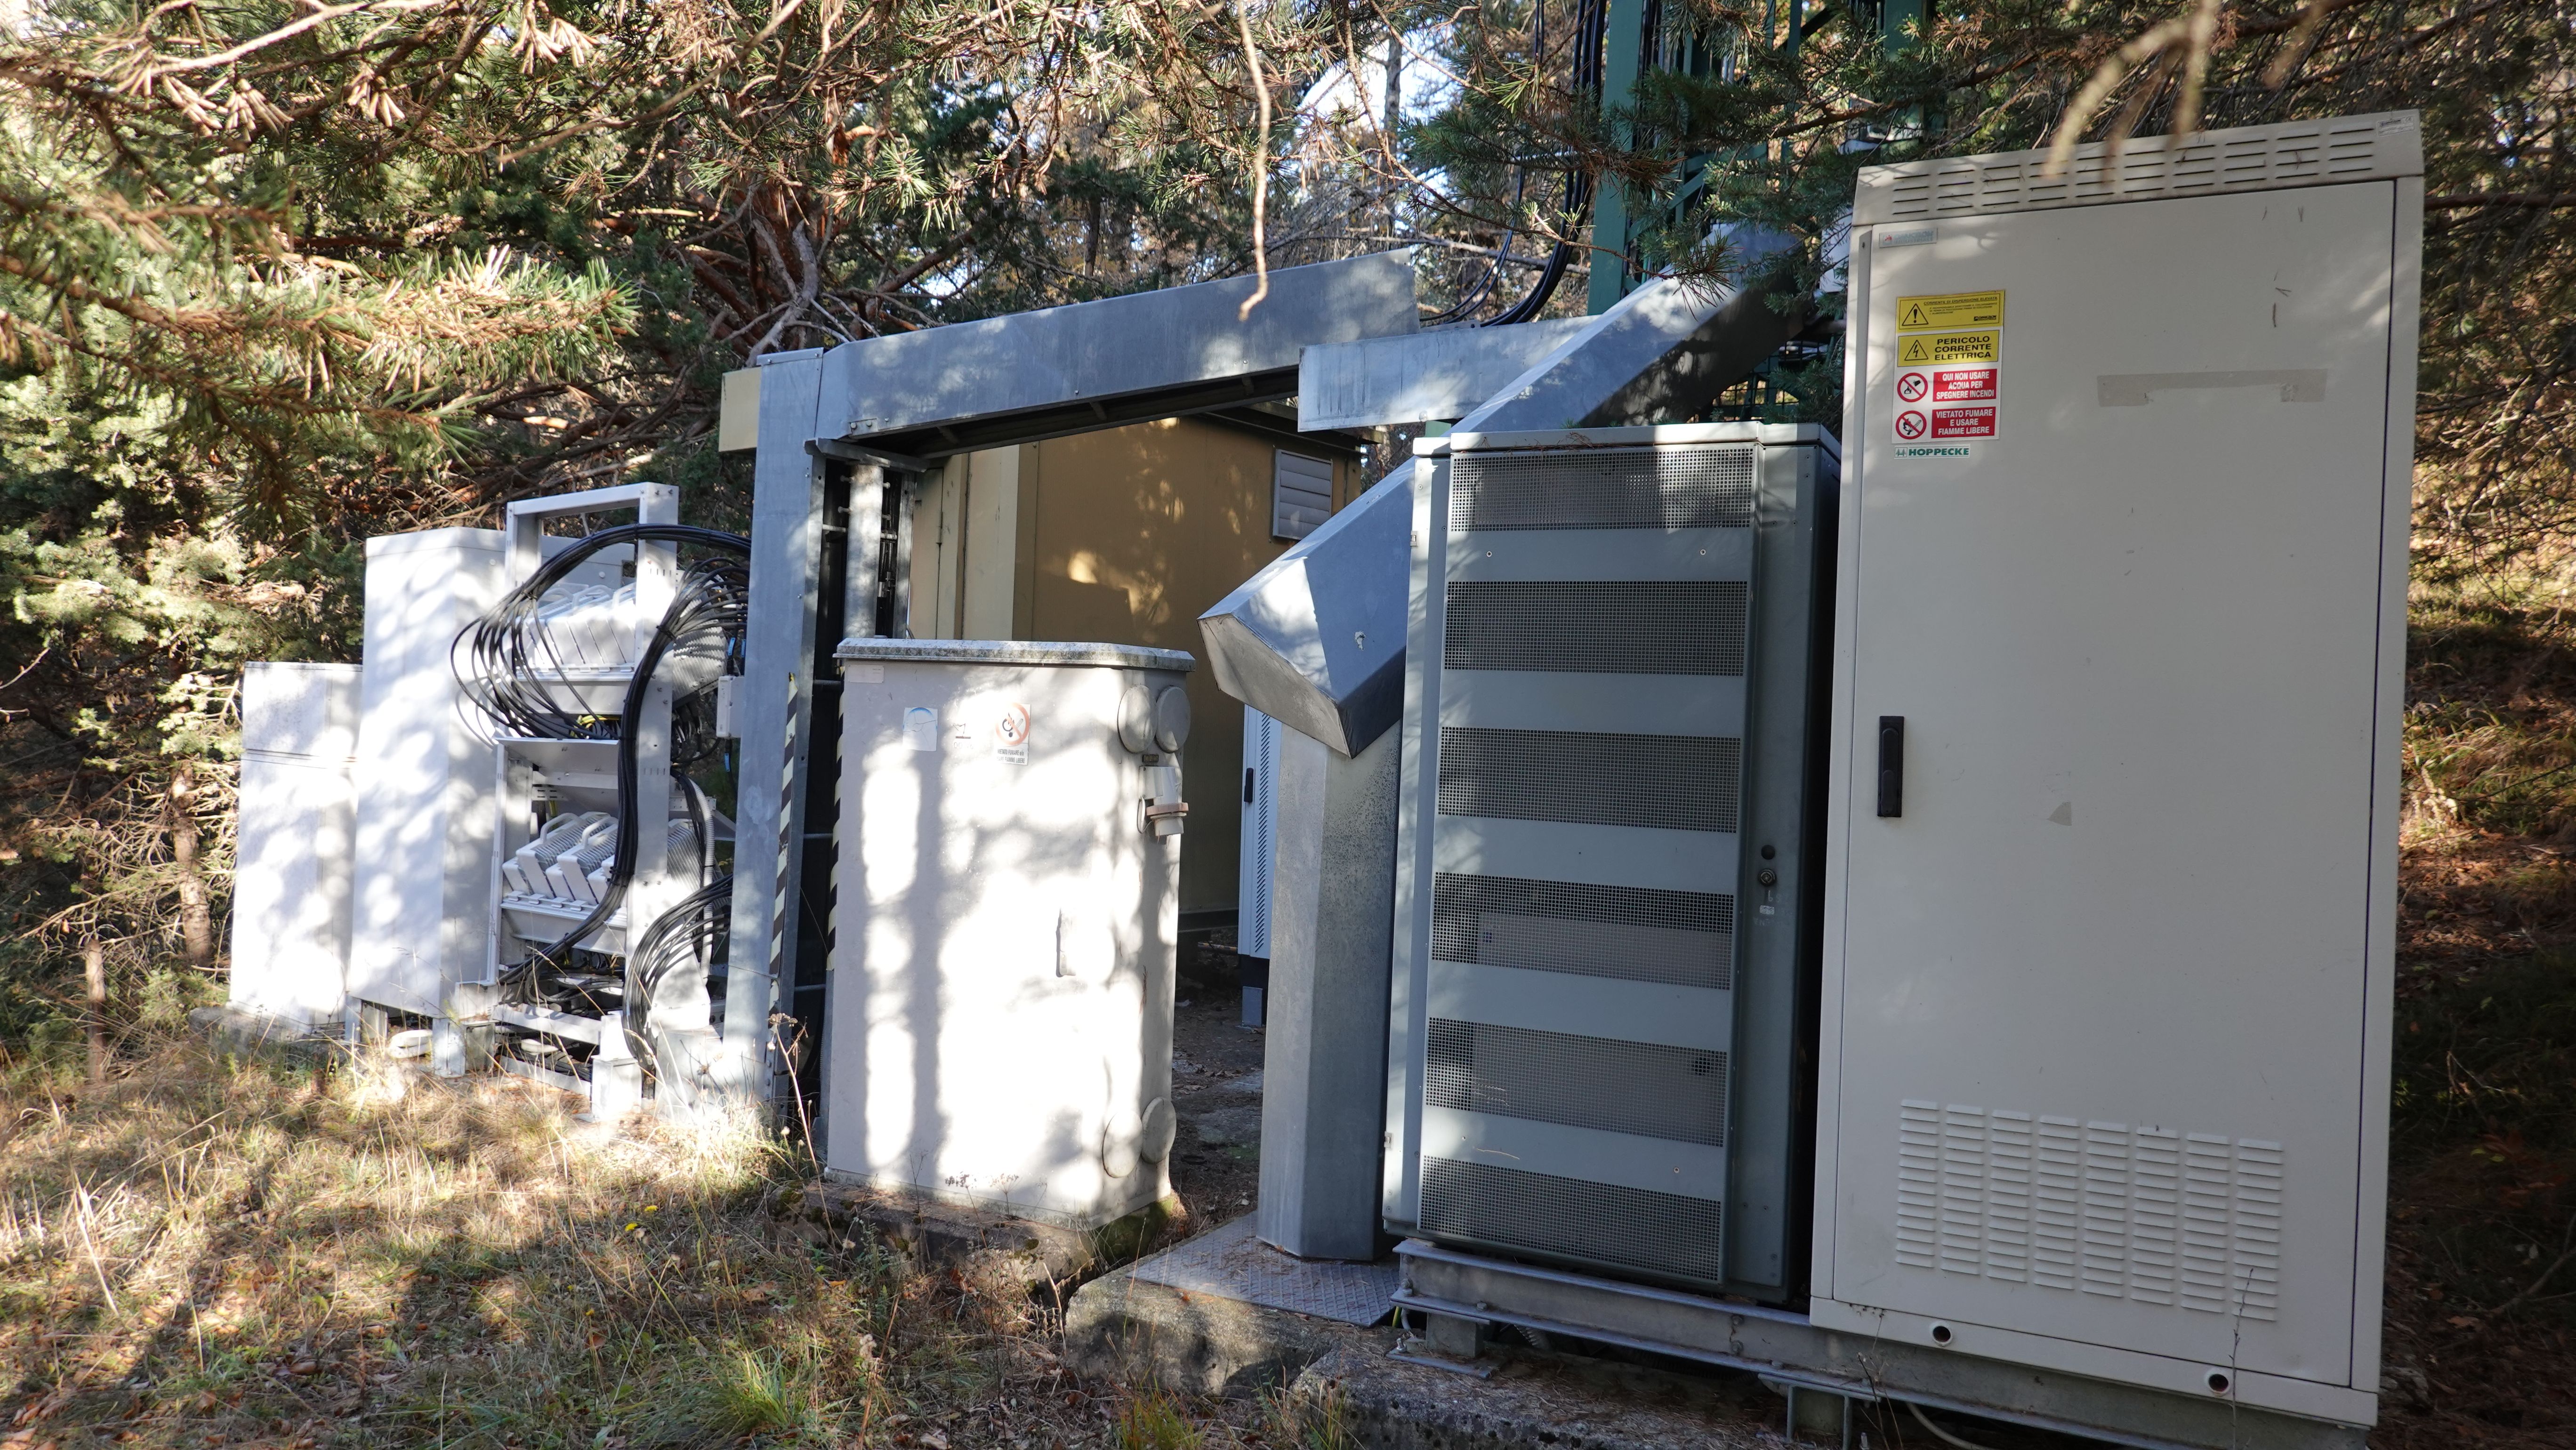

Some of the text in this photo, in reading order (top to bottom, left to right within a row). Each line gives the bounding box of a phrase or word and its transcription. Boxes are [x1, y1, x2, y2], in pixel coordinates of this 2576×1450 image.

[1937, 336, 1990, 345] PERICOLO
[1935, 344, 1991, 353] CORRENTE
[1935, 352, 1991, 360] ELETTRICA
[1942, 371, 1989, 381] QUI NON USARE
[1948, 380, 1983, 390] ACQUA PER
[1936, 389, 1994, 399] SPEGNERE INCENDI
[1936, 409, 1993, 419] VIETATO FUMARE
[1956, 418, 1979, 426] USARE
[1938, 426, 1989, 435] FIAMME LIBERE
[1908, 448, 1969, 456] HOPPECKE
